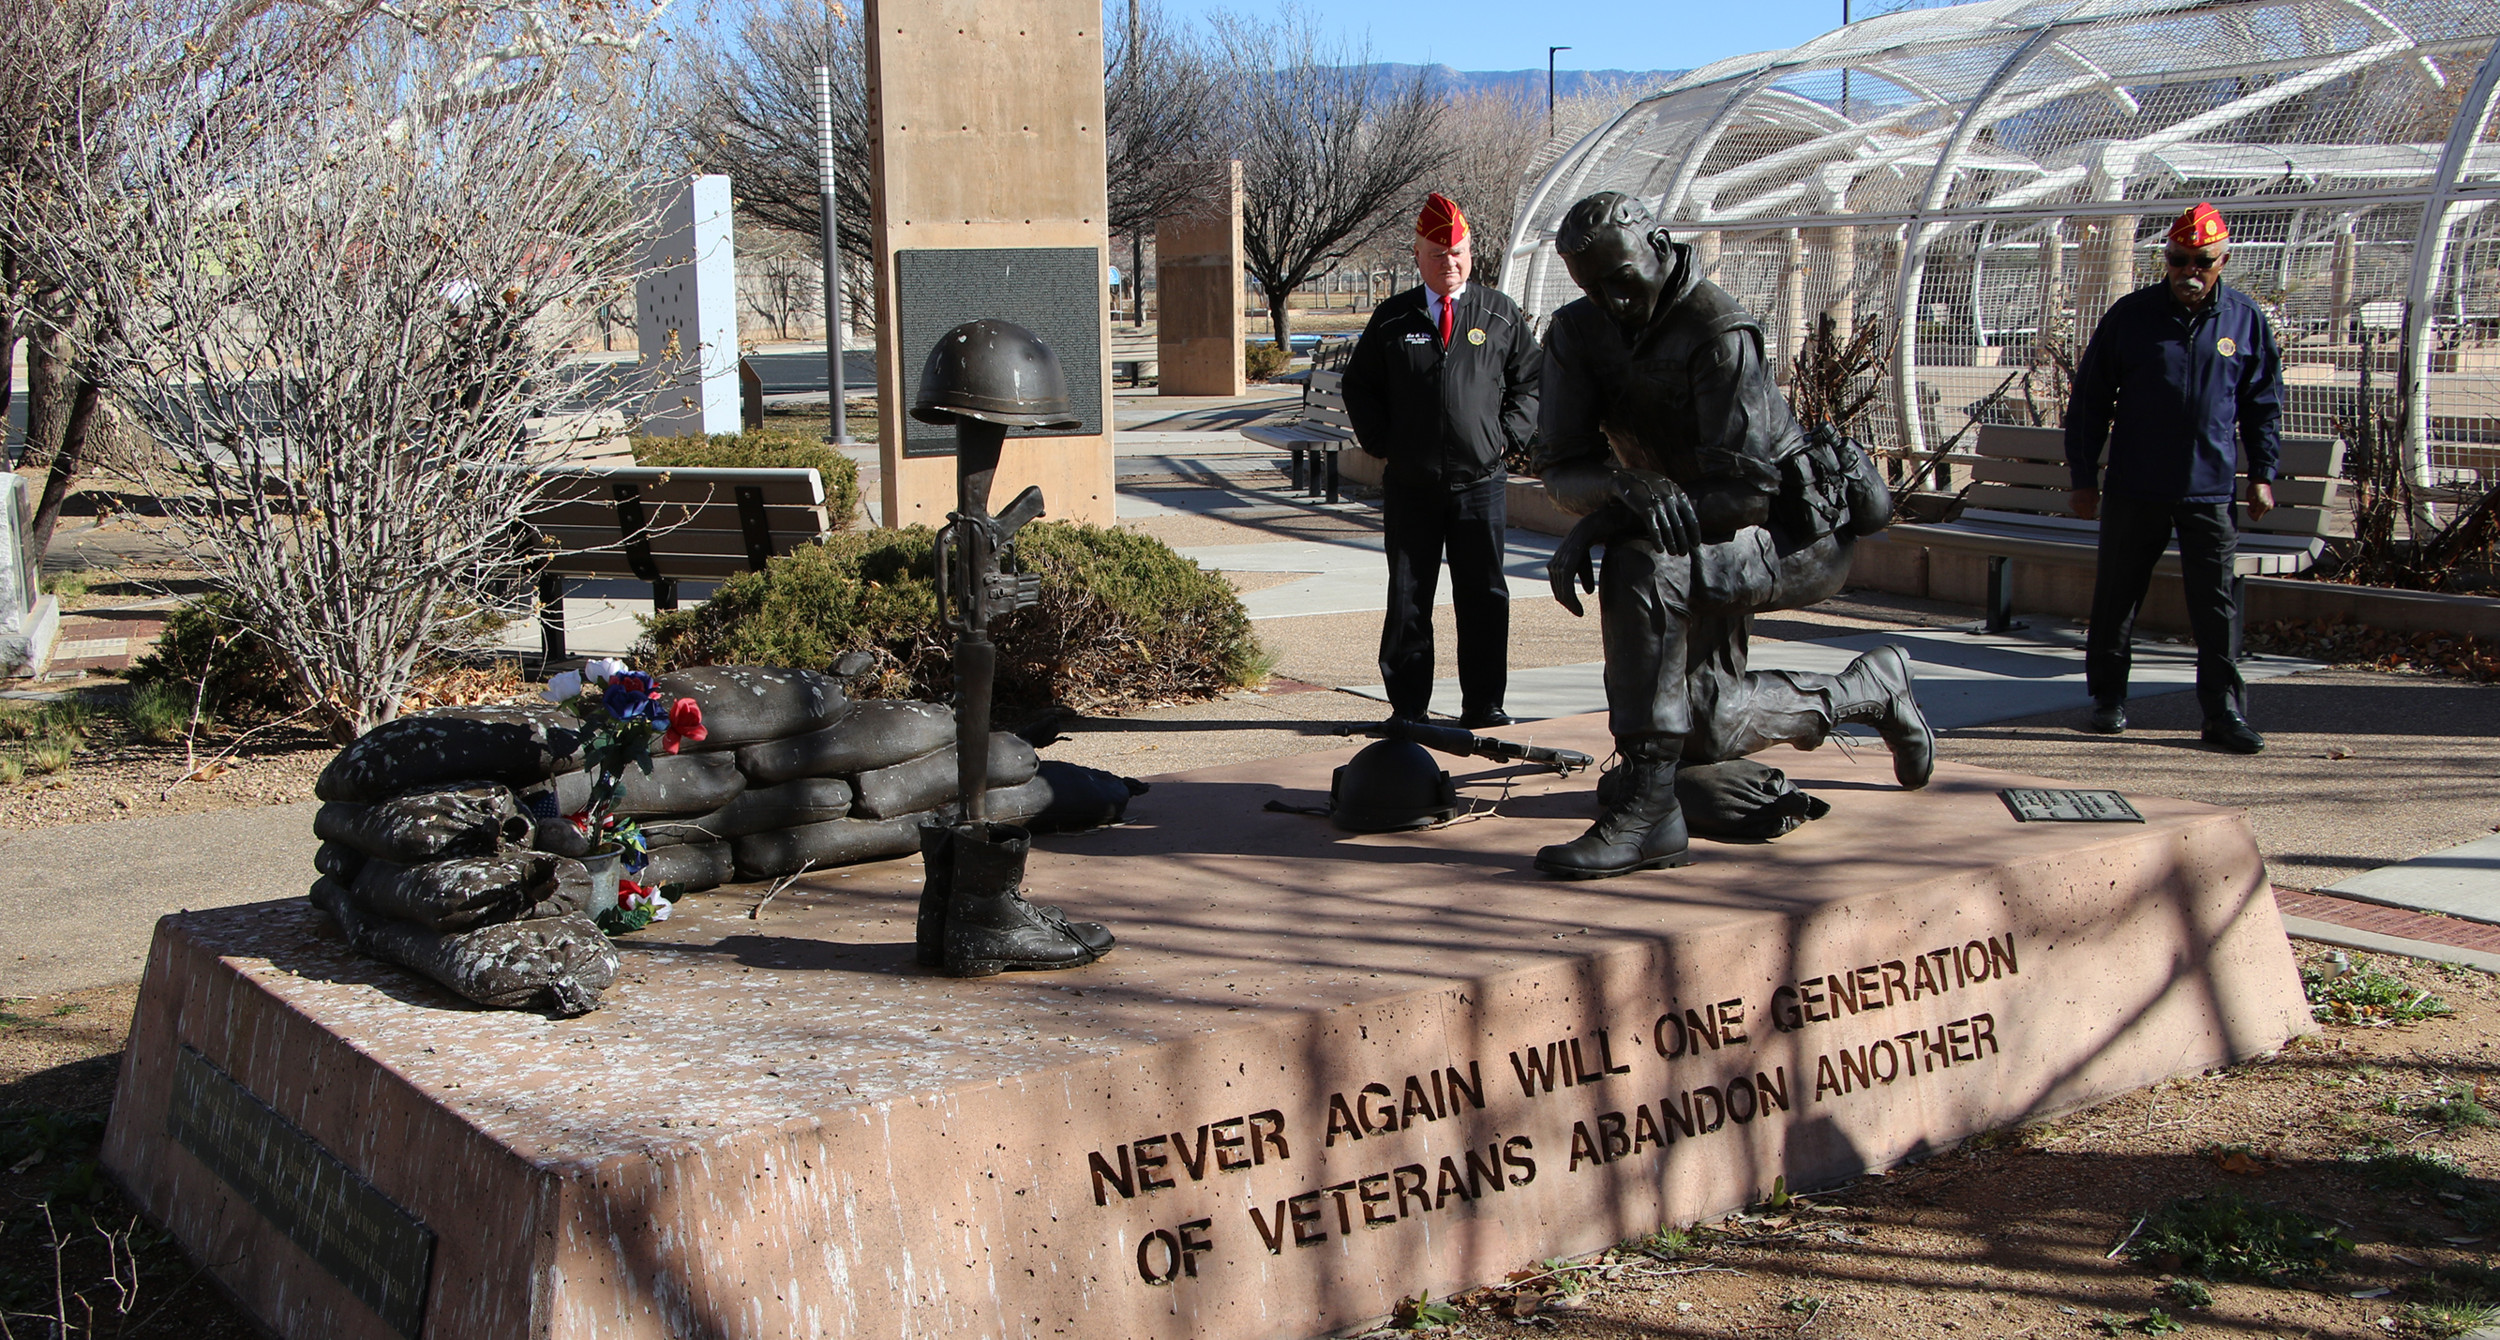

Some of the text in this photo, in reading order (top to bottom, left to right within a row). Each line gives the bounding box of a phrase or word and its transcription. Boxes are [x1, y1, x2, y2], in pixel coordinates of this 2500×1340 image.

[866, 0, 886, 324] VIETNAM
[1088, 932, 2018, 1206] NEVER AGAIN WILL ONE GENERATION
[1137, 1013, 1999, 1286] OF VETERANS ABANDON ANOTHER
[341, 1236, 368, 1272] FROM
[359, 1213, 382, 1246] WAR
